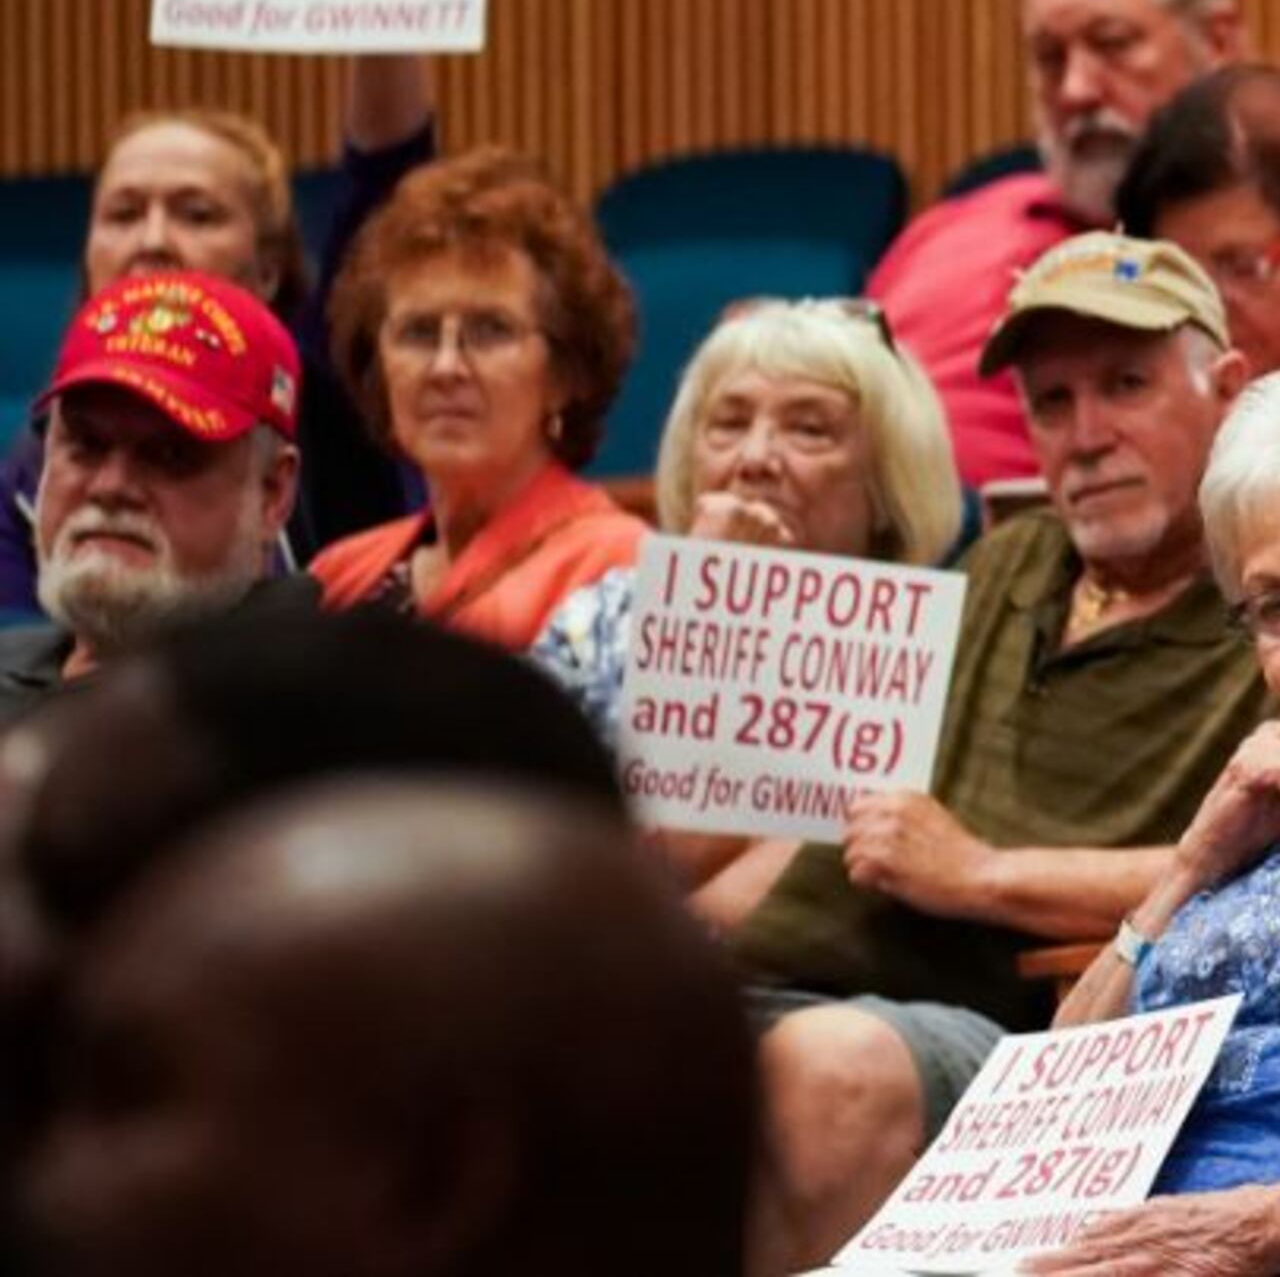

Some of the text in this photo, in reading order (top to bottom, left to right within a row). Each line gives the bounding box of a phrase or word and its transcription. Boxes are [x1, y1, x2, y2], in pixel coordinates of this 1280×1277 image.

[303, 0, 470, 34] GWINNETT
[664, 551, 932, 636] I SUPPORT
[636, 614, 934, 705] SHERIFF CONWAY
[631, 691, 904, 776] and 287(g)
[622, 758, 698, 802] Good
[700, 766, 745, 811] for
[991, 1010, 1216, 1097] I SUPPORT
[939, 1072, 1202, 1153] SHERIFF CONWAY
[902, 1140, 1145, 1204] and 287(g)
[860, 1222, 940, 1254] Good
[930, 1224, 980, 1260] for
